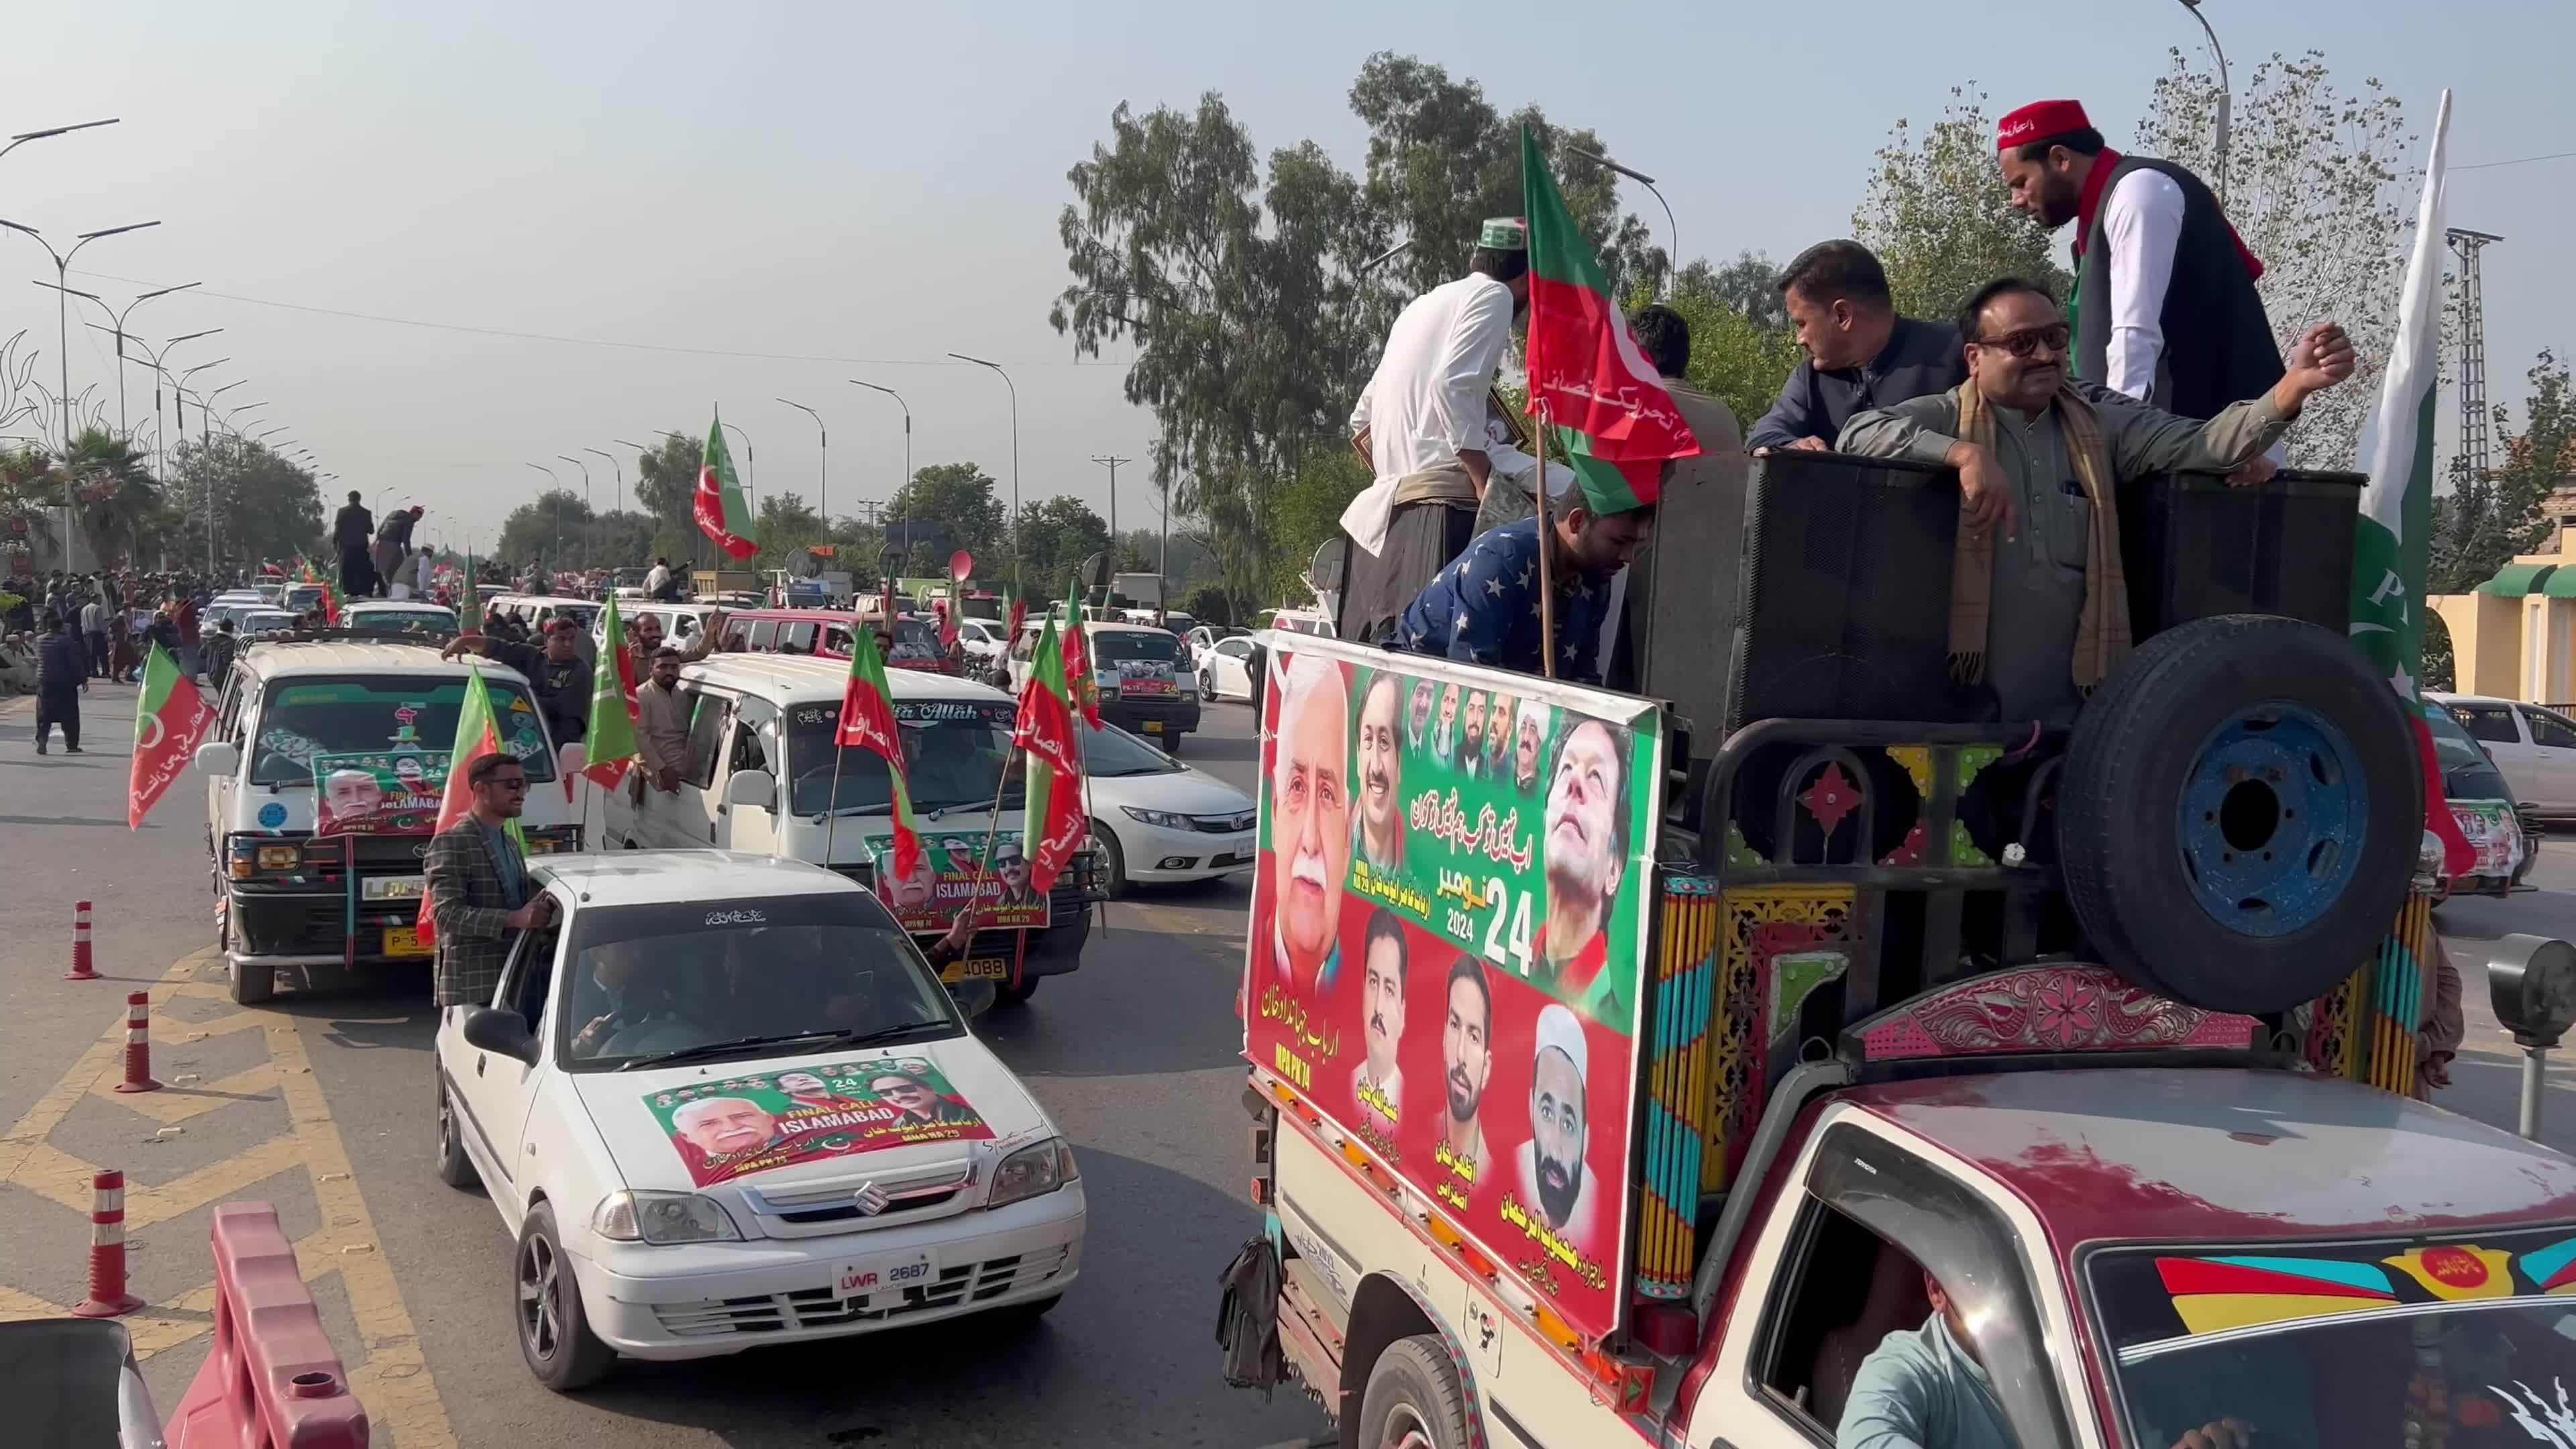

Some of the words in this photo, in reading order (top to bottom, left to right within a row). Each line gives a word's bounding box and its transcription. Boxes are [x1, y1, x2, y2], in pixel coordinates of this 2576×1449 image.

[1164, 683, 1177, 693] 24
[920, 703, 977, 720] Allah
[428, 769, 442, 779] 24
[1434, 786, 1458, 839] نہیں
[1463, 802, 1491, 855] کب
[1483, 810, 1497, 853] تو
[1490, 806, 1517, 862] نہیں
[1510, 833, 1533, 874] اب
[936, 881, 1002, 898] ISLAMABAD
[943, 871, 971, 881] FINAL
[1361, 876, 1369, 894] 29
[1370, 869, 1383, 897] خان
[1437, 866, 1488, 910] نومبر
[1398, 881, 1414, 908] عامر
[1414, 888, 1431, 922] ارباب
[1447, 906, 1474, 944] 2024
[1484, 876, 1534, 978] 24
[964, 960, 1003, 976] 4088
[1261, 981, 1280, 1018] خان
[1307, 1017, 1340, 1066] ارباب
[1275, 1041, 1291, 1077] MPA
[1291, 1053, 1301, 1086] PK
[1301, 1061, 1310, 1092] 74
[832, 1078, 857, 1088] 24
[777, 1107, 895, 1134] ISLAMABAD
[786, 1105, 836, 1119] FINAL
[839, 1099, 879, 1111] CALL
[773, 1137, 815, 1153] ارباب
[863, 1126, 887, 1138] خان
[945, 1128, 961, 1138] 29
[1436, 1138, 1454, 1169] خان
[1452, 1152, 1477, 1186] اظہر
[1540, 1224, 1578, 1271] محبوب
[842, 1272, 878, 1290] LWR
[890, 1262, 930, 1282] 2687
